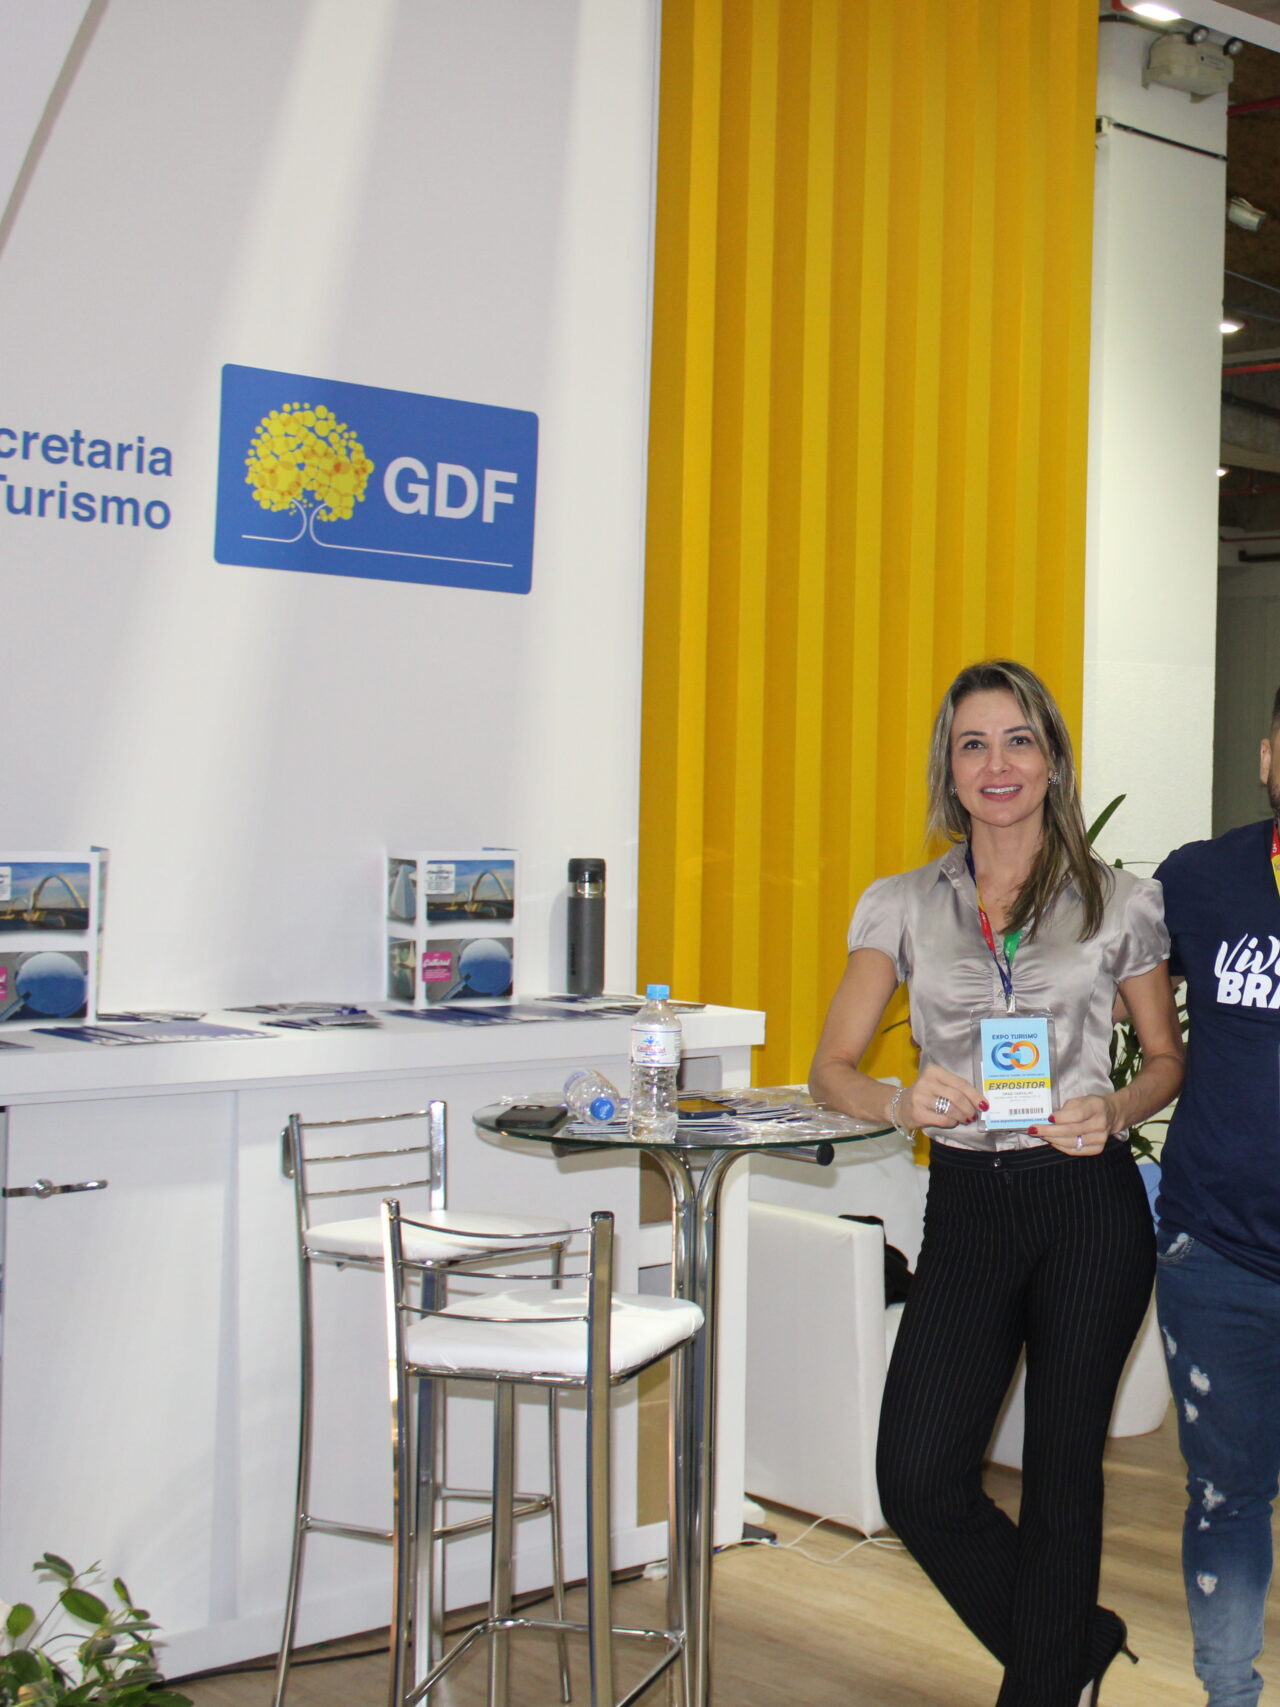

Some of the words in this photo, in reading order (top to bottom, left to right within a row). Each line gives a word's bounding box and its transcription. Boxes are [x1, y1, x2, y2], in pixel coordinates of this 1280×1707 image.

[0, 474, 171, 530] urismo
[383, 456, 518, 524] GDF
[988, 1081, 1046, 1091] EXPOSITOR
